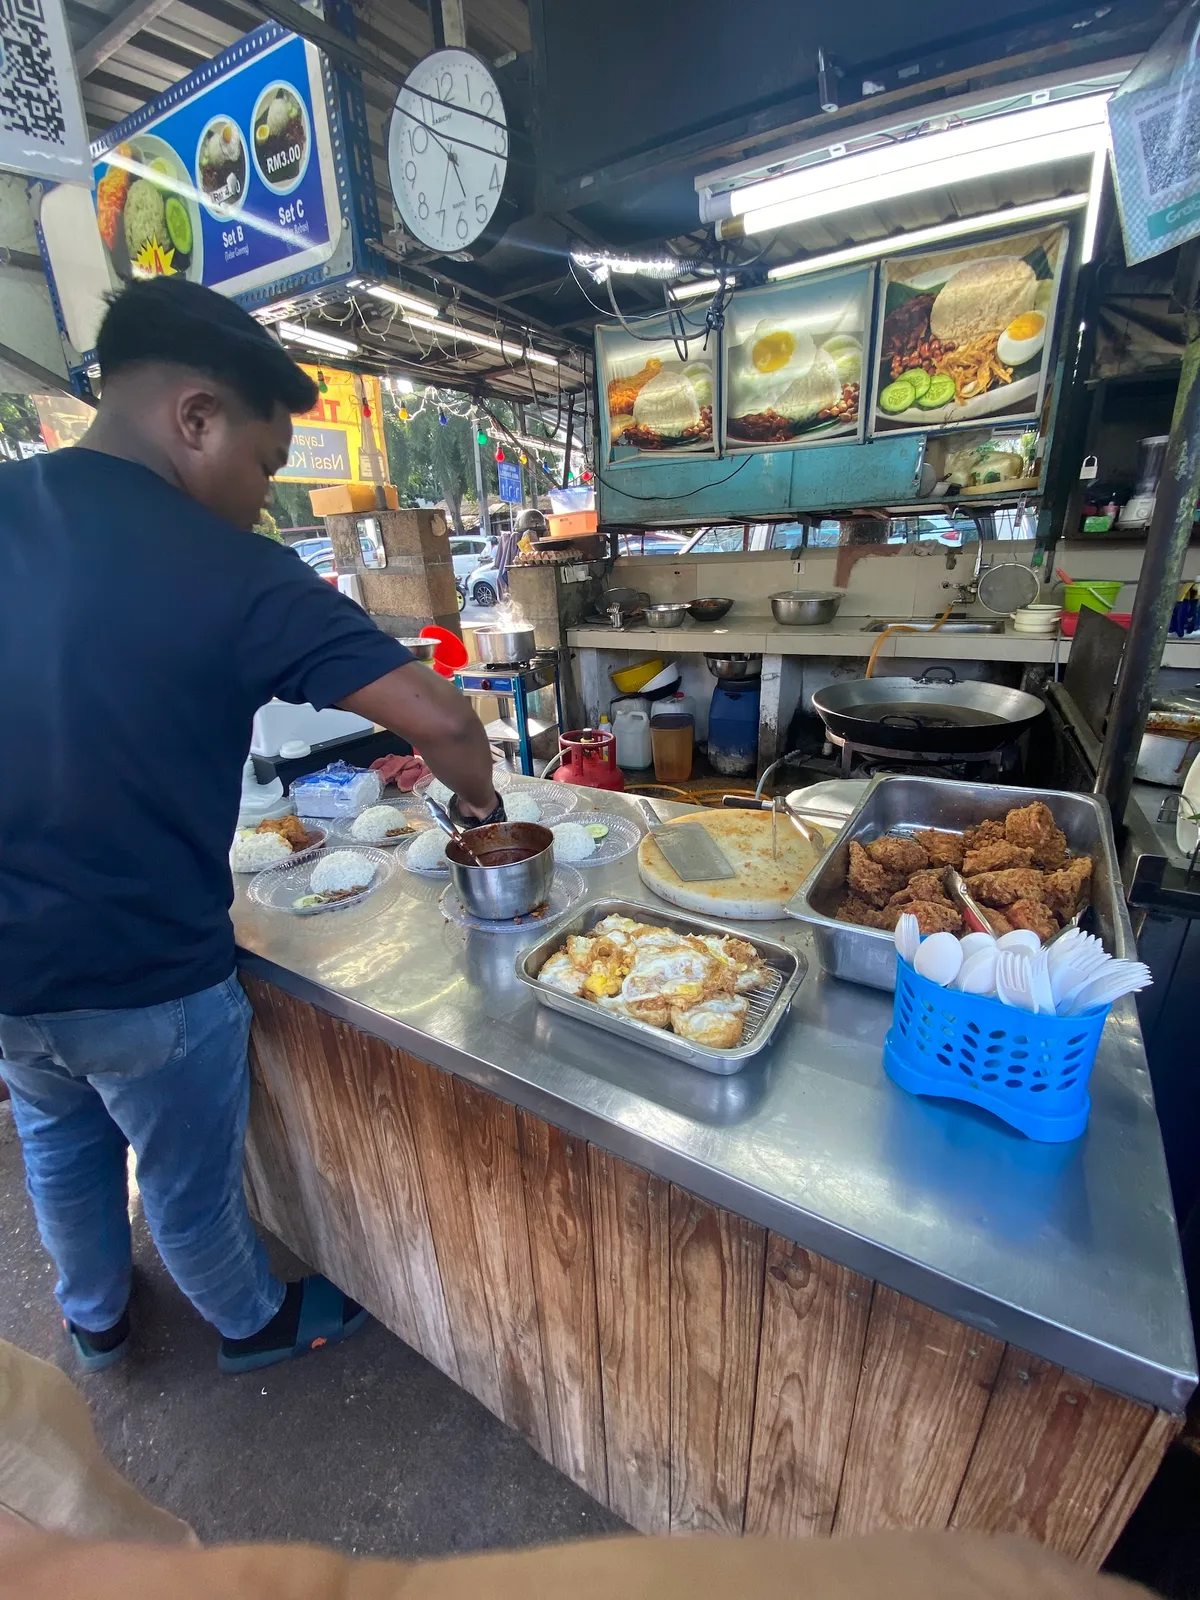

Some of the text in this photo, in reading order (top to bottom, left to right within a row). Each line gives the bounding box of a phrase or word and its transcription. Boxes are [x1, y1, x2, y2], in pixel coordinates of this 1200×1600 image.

[435, 72, 455, 103] 12
[464, 73, 471, 103] 1
[420, 93, 435, 125] 11
[480, 91, 496, 125] 2
[407, 125, 429, 157] 10
[494, 125, 506, 155] 3
[266, 144, 301, 174] RM3.00
[404, 160, 417, 190] 9
[488, 163, 502, 193] 4
[279, 199, 305, 226] Set C
[417, 191, 430, 220] 8
[474, 194, 488, 224] 5
[222, 226, 244, 248] Set B
[435, 209, 446, 238] 7
[456, 211, 469, 240] 6
